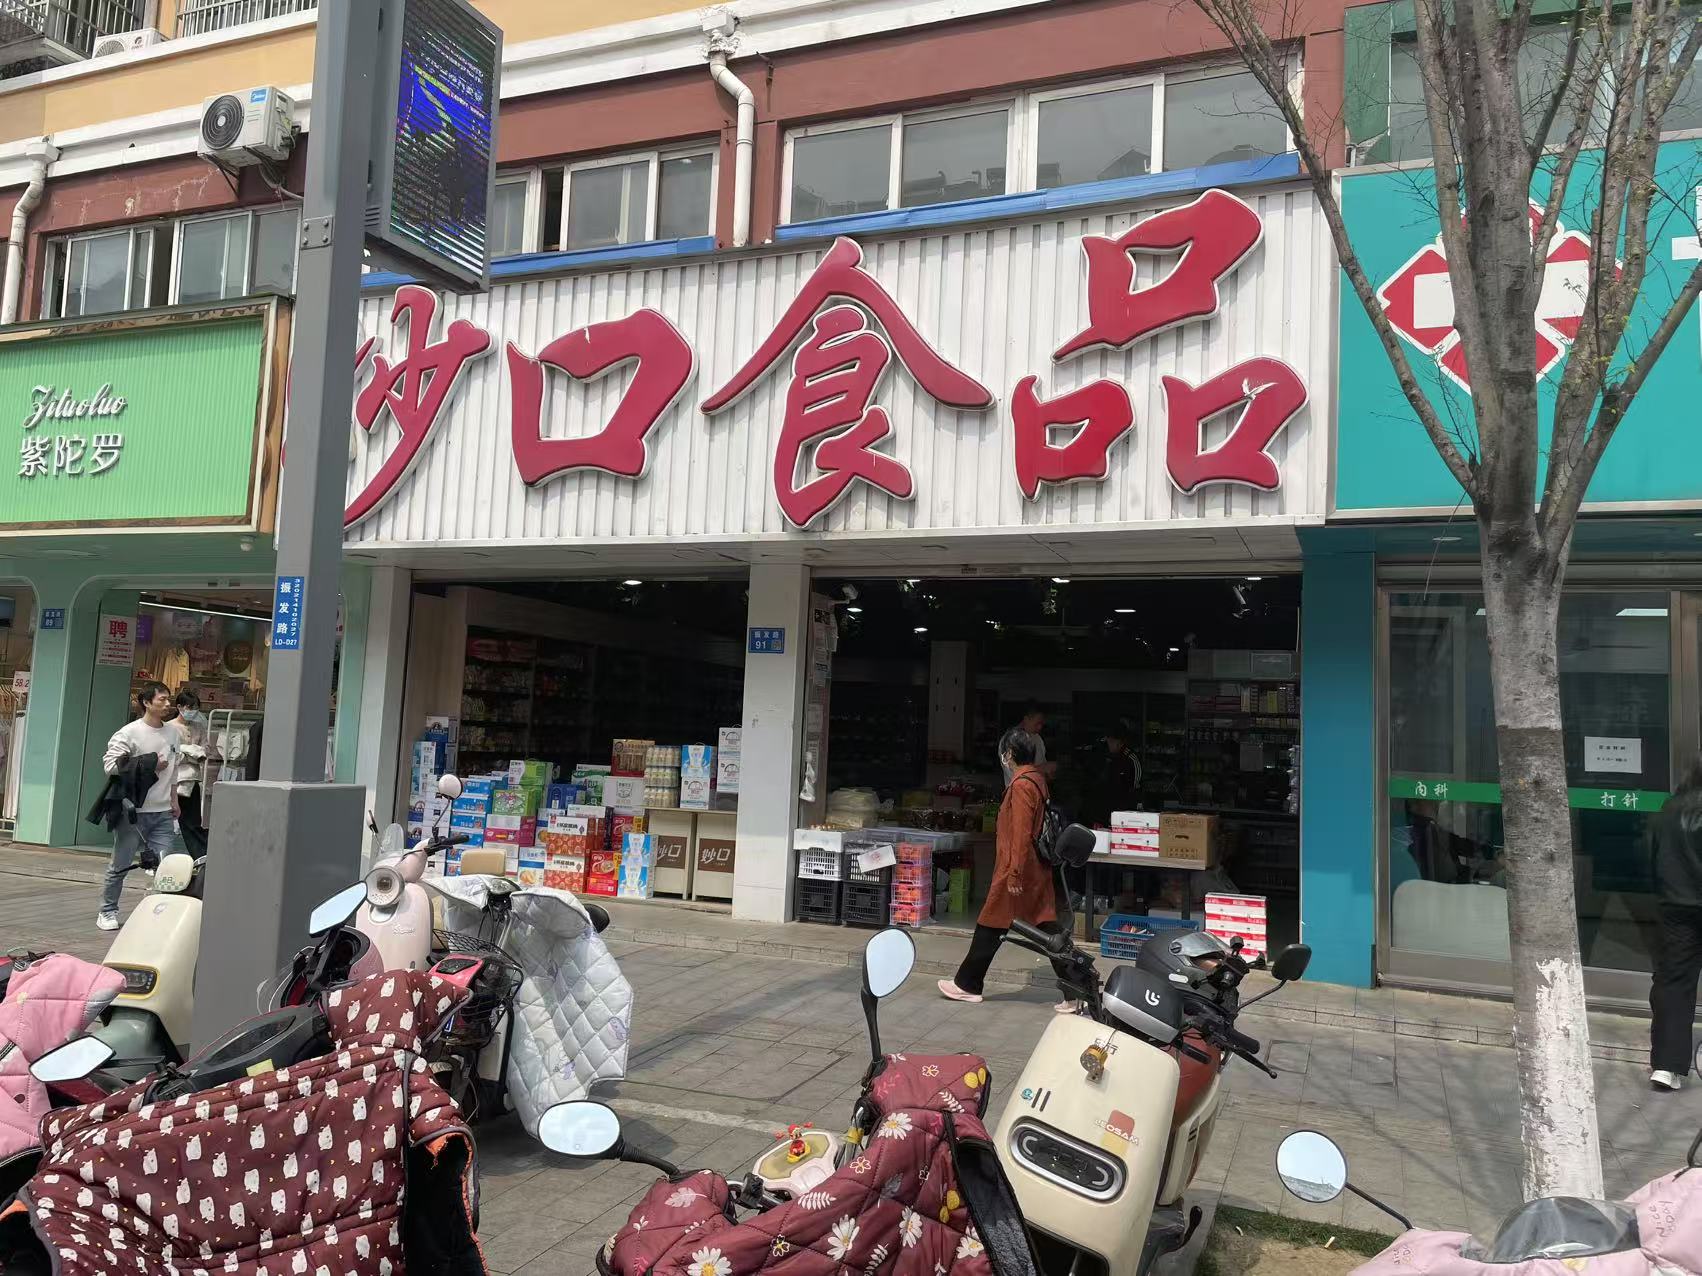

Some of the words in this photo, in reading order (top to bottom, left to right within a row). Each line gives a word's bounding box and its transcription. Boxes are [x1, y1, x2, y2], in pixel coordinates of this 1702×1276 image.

[18, 433, 125, 478] 紫陀罗
[276, 582, 293, 635] 振发路
[109, 620, 128, 639] 聘
[755, 641, 767, 650] 91
[1415, 781, 1449, 799] 内科
[1600, 791, 1639, 810] 打针
[700, 847, 731, 864] 妙口
